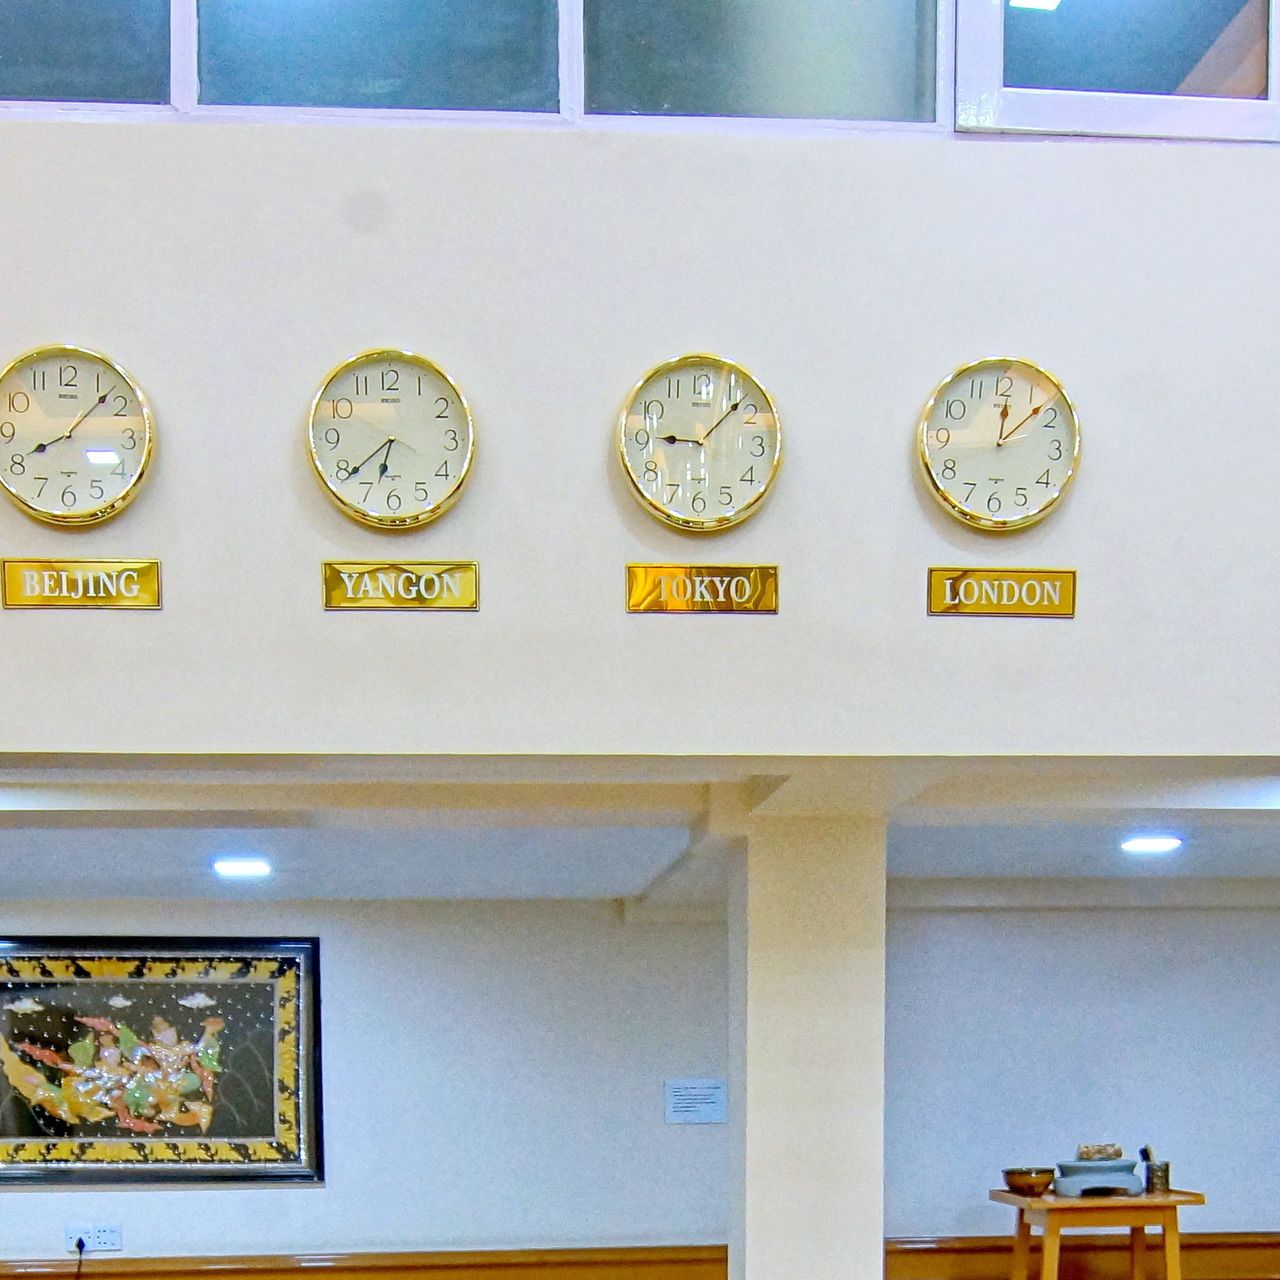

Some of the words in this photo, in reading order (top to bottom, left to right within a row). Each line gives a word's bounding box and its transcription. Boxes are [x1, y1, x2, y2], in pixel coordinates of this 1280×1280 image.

[33, 370, 45, 390] 11
[59, 365, 78, 387] 12
[355, 376, 368, 395] 11
[381, 369, 399, 391] 12
[668, 379, 680, 399] 11
[971, 379, 983, 399] 11
[995, 377, 1013, 397] 12
[8, 391, 29, 413] 10
[113, 395, 127, 417] 2
[331, 398, 353, 419] 10
[435, 397, 449, 418] 2
[644, 400, 664, 421] 10
[945, 400, 966, 420] 10
[743, 404, 758, 424] 2
[1043, 408, 1057, 428] 2
[0, 421, 15, 444] 9
[121, 428, 136, 450] 3
[325, 428, 340, 450] 9
[443, 429, 458, 451] 3
[635, 429, 649, 451] 9
[936, 428, 950, 449] 9
[750, 436, 765, 457] 3
[1048, 440, 1062, 461] 3
[10, 453, 25, 475] 8
[110, 460, 127, 479] 4
[336, 460, 351, 481] 8
[435, 460, 449, 480] 4
[643, 460, 658, 481] 8
[942, 459, 956, 480] 8
[740, 465, 755, 485] 4
[1035, 468, 1050, 488] 4
[33, 478, 48, 498] 7
[61, 485, 77, 507] 6
[89, 480, 104, 499] 5
[359, 482, 373, 502] 7
[415, 482, 428, 501] 5
[666, 483, 680, 505] 7
[719, 486, 732, 505] 5
[962, 482, 977, 503] 7
[1014, 488, 1027, 506] 5
[386, 488, 402, 510] 6
[691, 491, 706, 513] 6
[987, 491, 1002, 512] 6
[24, 571, 139, 599] BEIJING
[340, 572, 462, 599] YANGON
[658, 575, 752, 602] TOKYO
[944, 579, 1061, 606] LONDON
